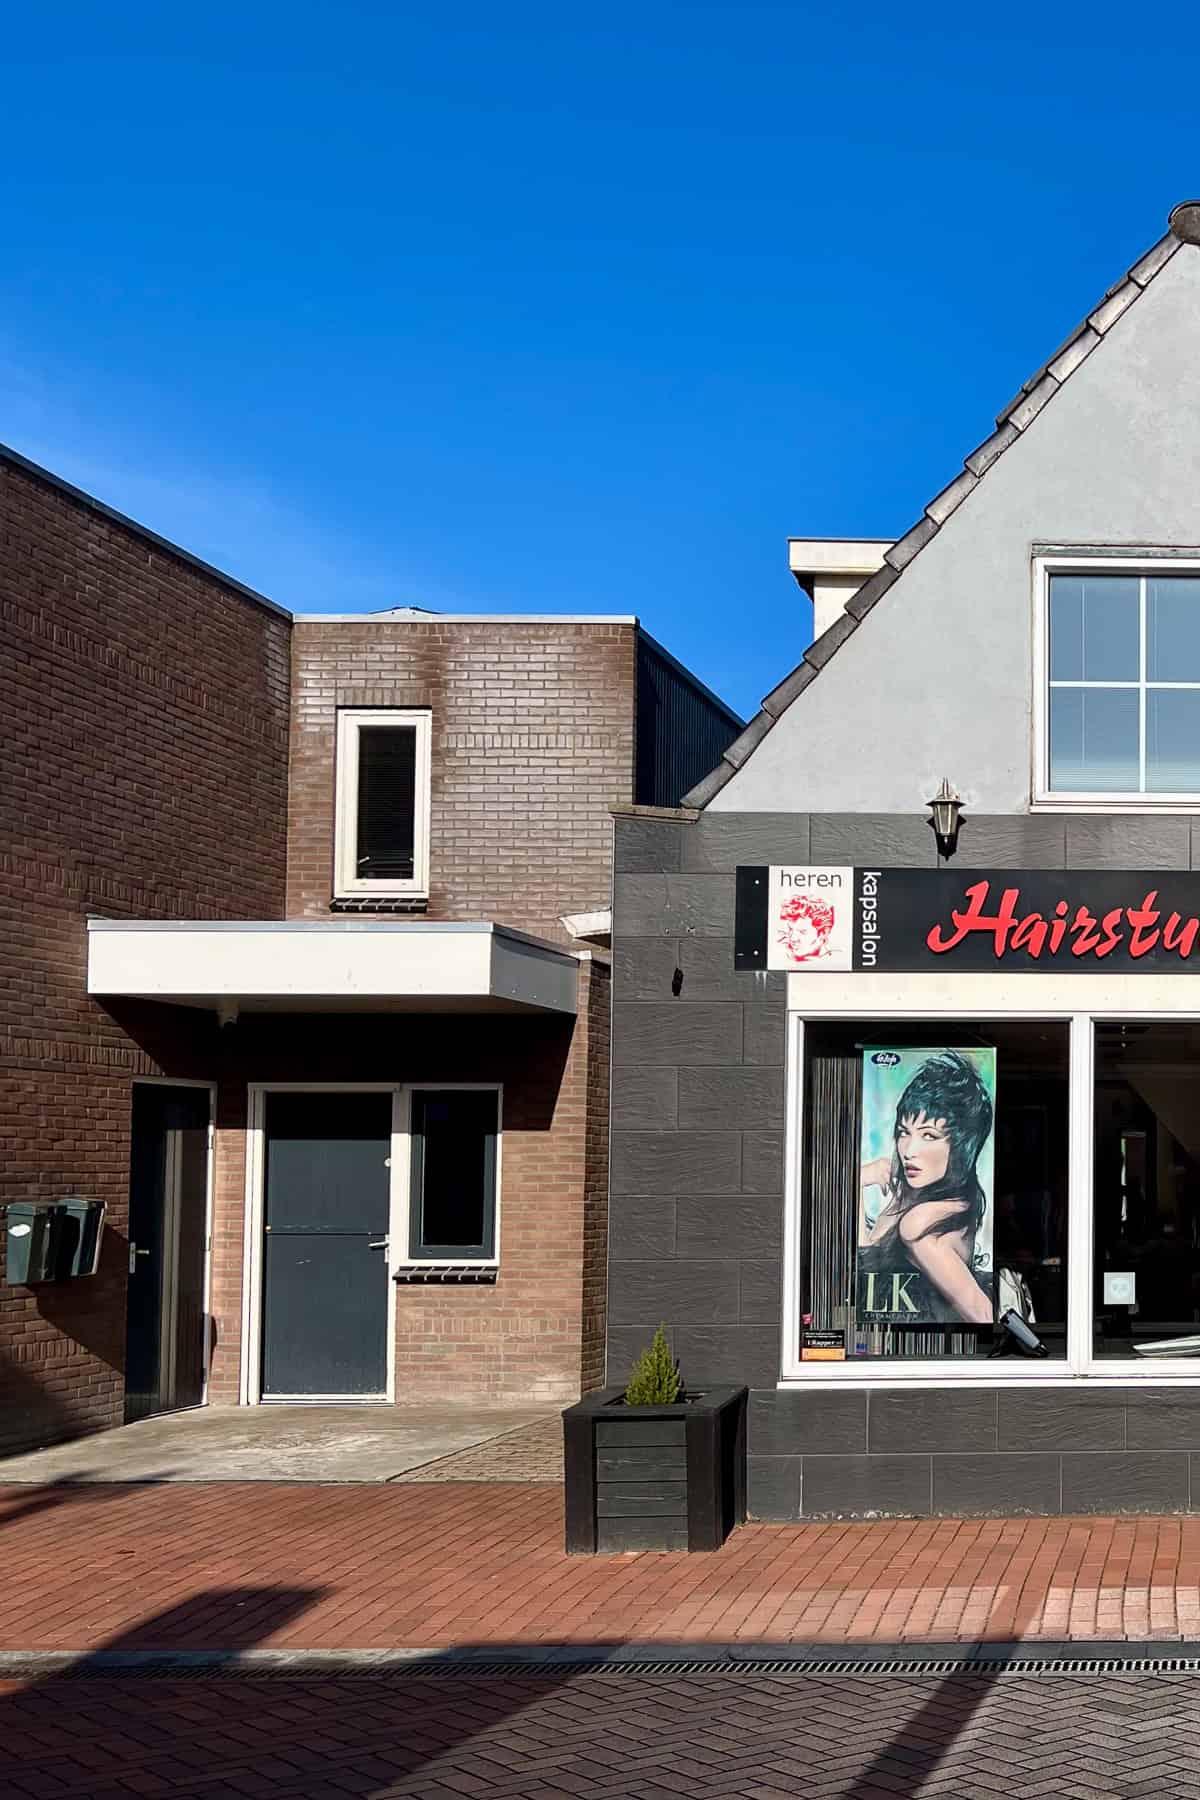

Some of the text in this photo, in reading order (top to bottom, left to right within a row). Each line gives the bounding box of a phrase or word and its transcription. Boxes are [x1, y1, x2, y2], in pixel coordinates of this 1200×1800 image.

[781, 870, 843, 888] heren
[859, 871, 882, 967] kapsalon
[863, 1272, 920, 1313] LK
